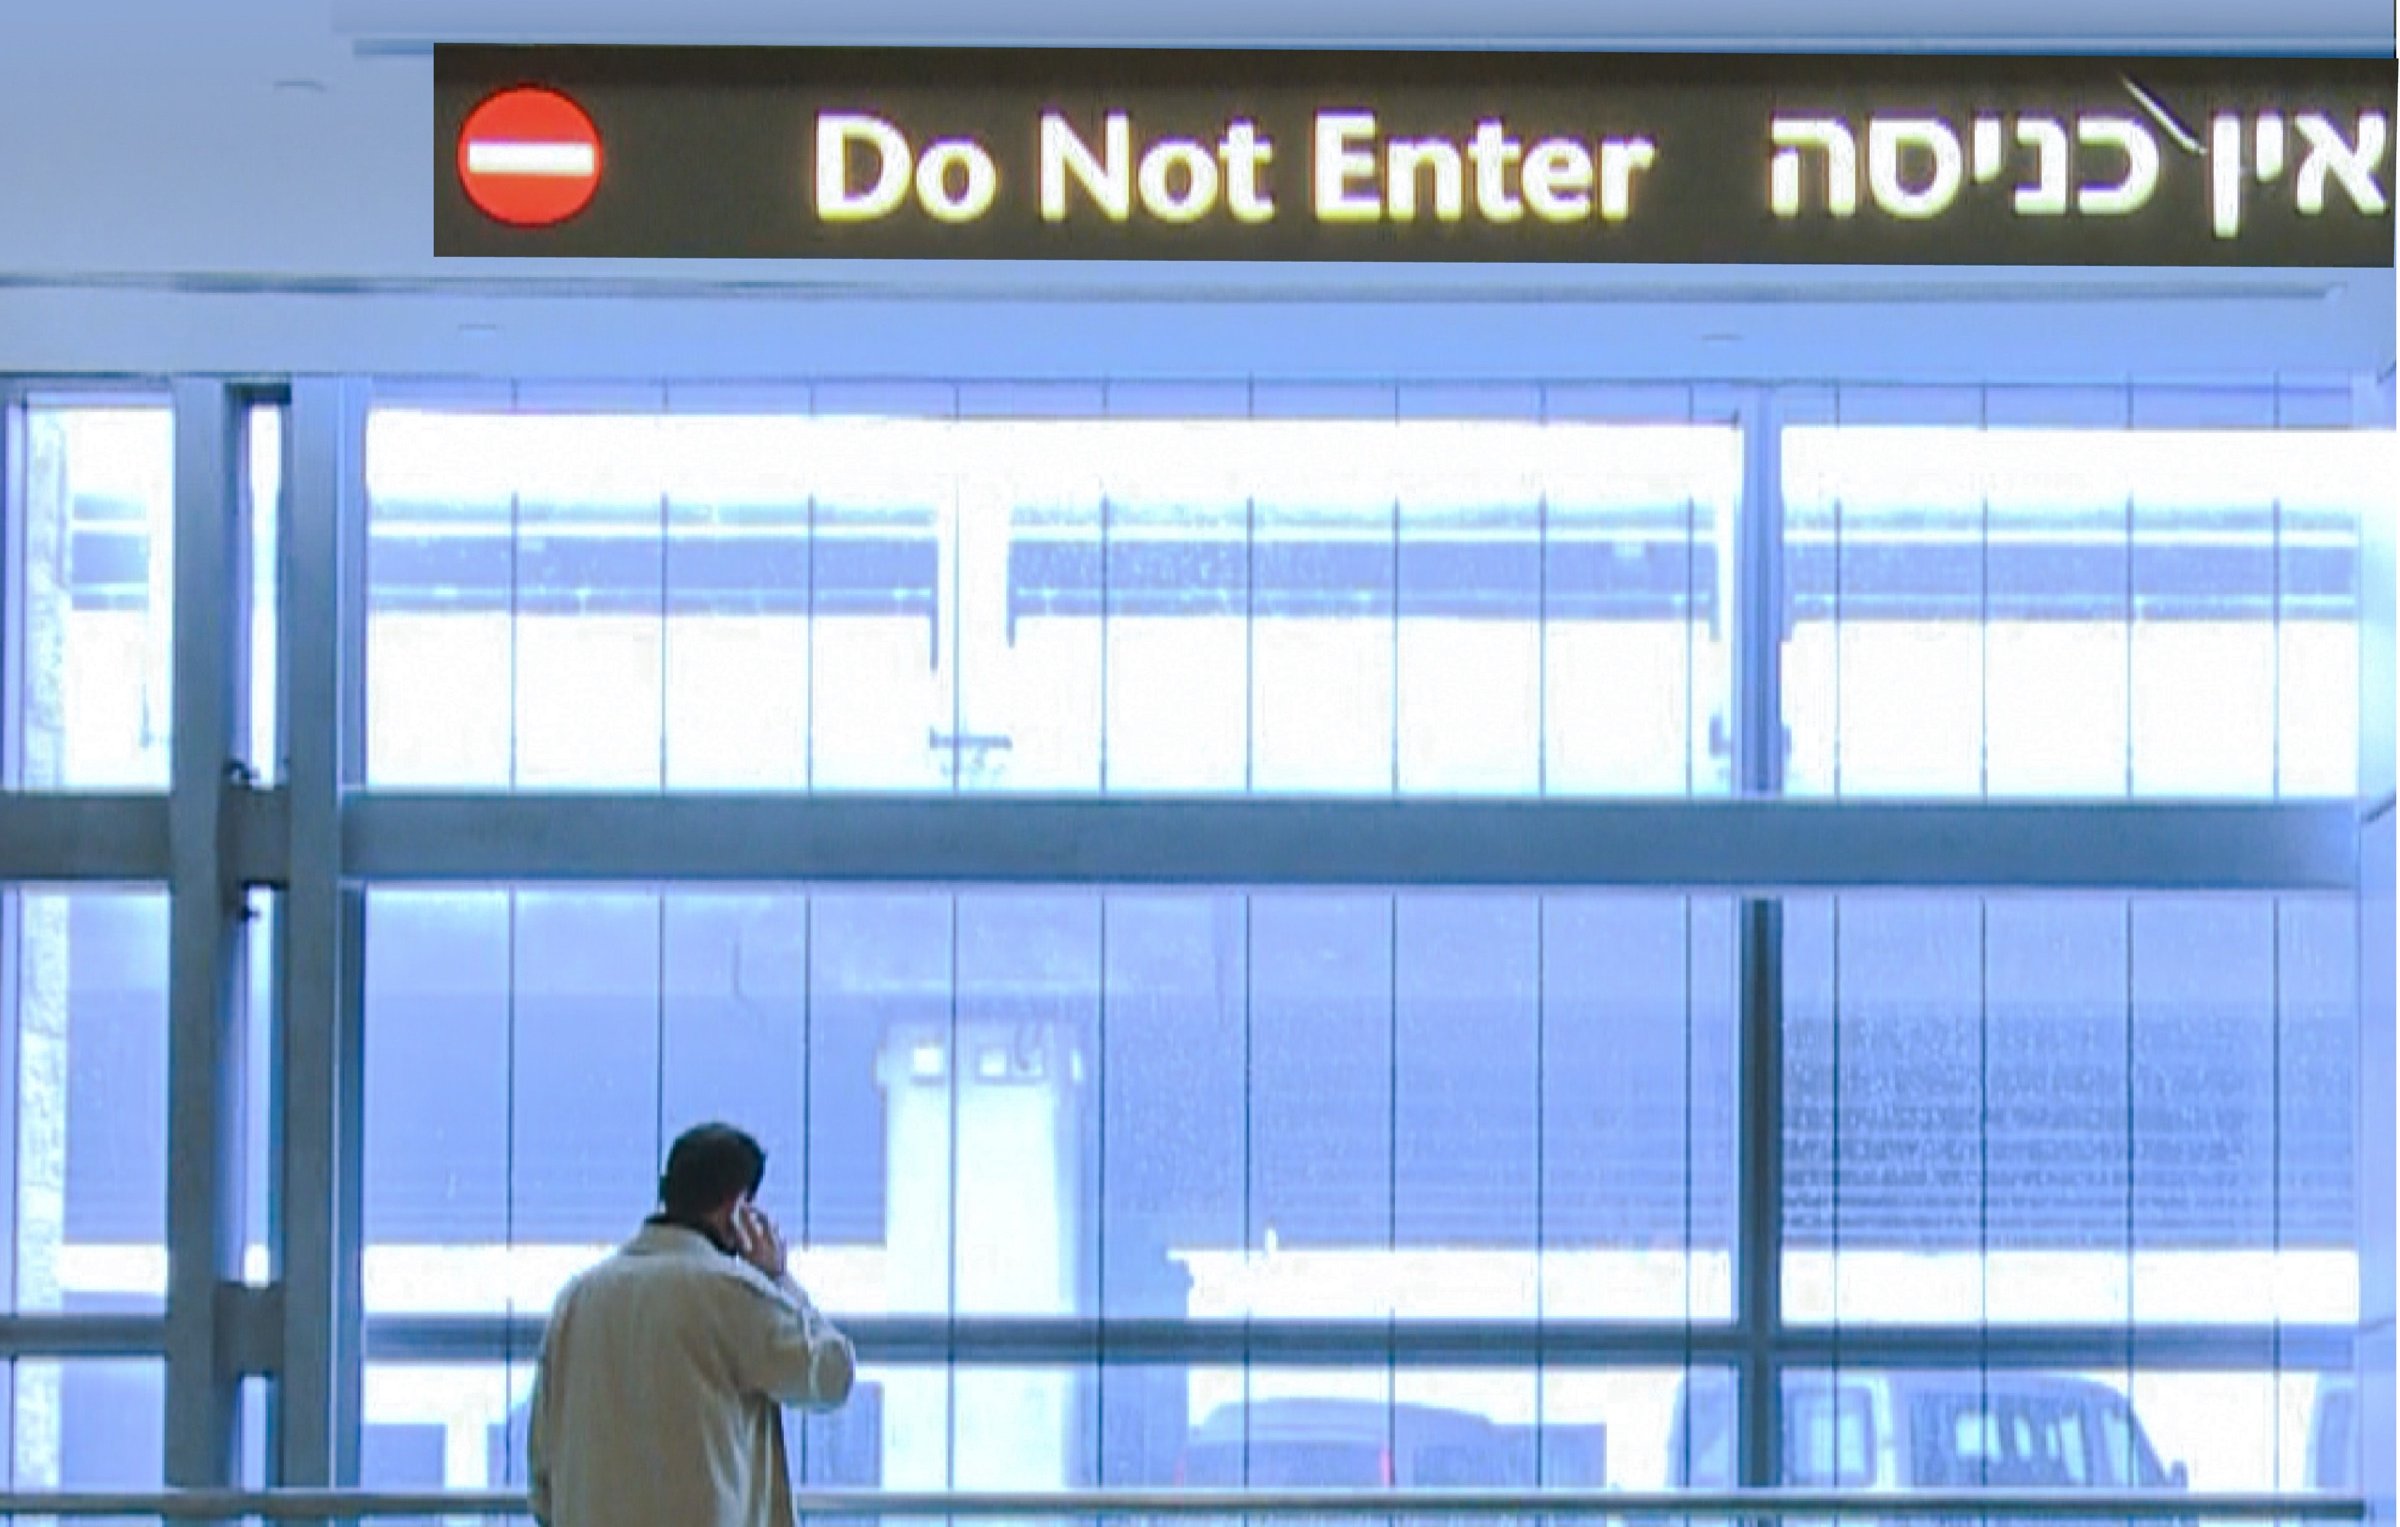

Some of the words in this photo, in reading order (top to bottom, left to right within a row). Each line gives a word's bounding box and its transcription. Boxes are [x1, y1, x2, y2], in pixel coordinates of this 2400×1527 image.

[814, 111, 998, 221] Do
[1038, 110, 1276, 223] Not
[1312, 111, 1657, 222] Enter
[1769, 113, 2161, 218] כניסה
[2208, 110, 2389, 238] אין
